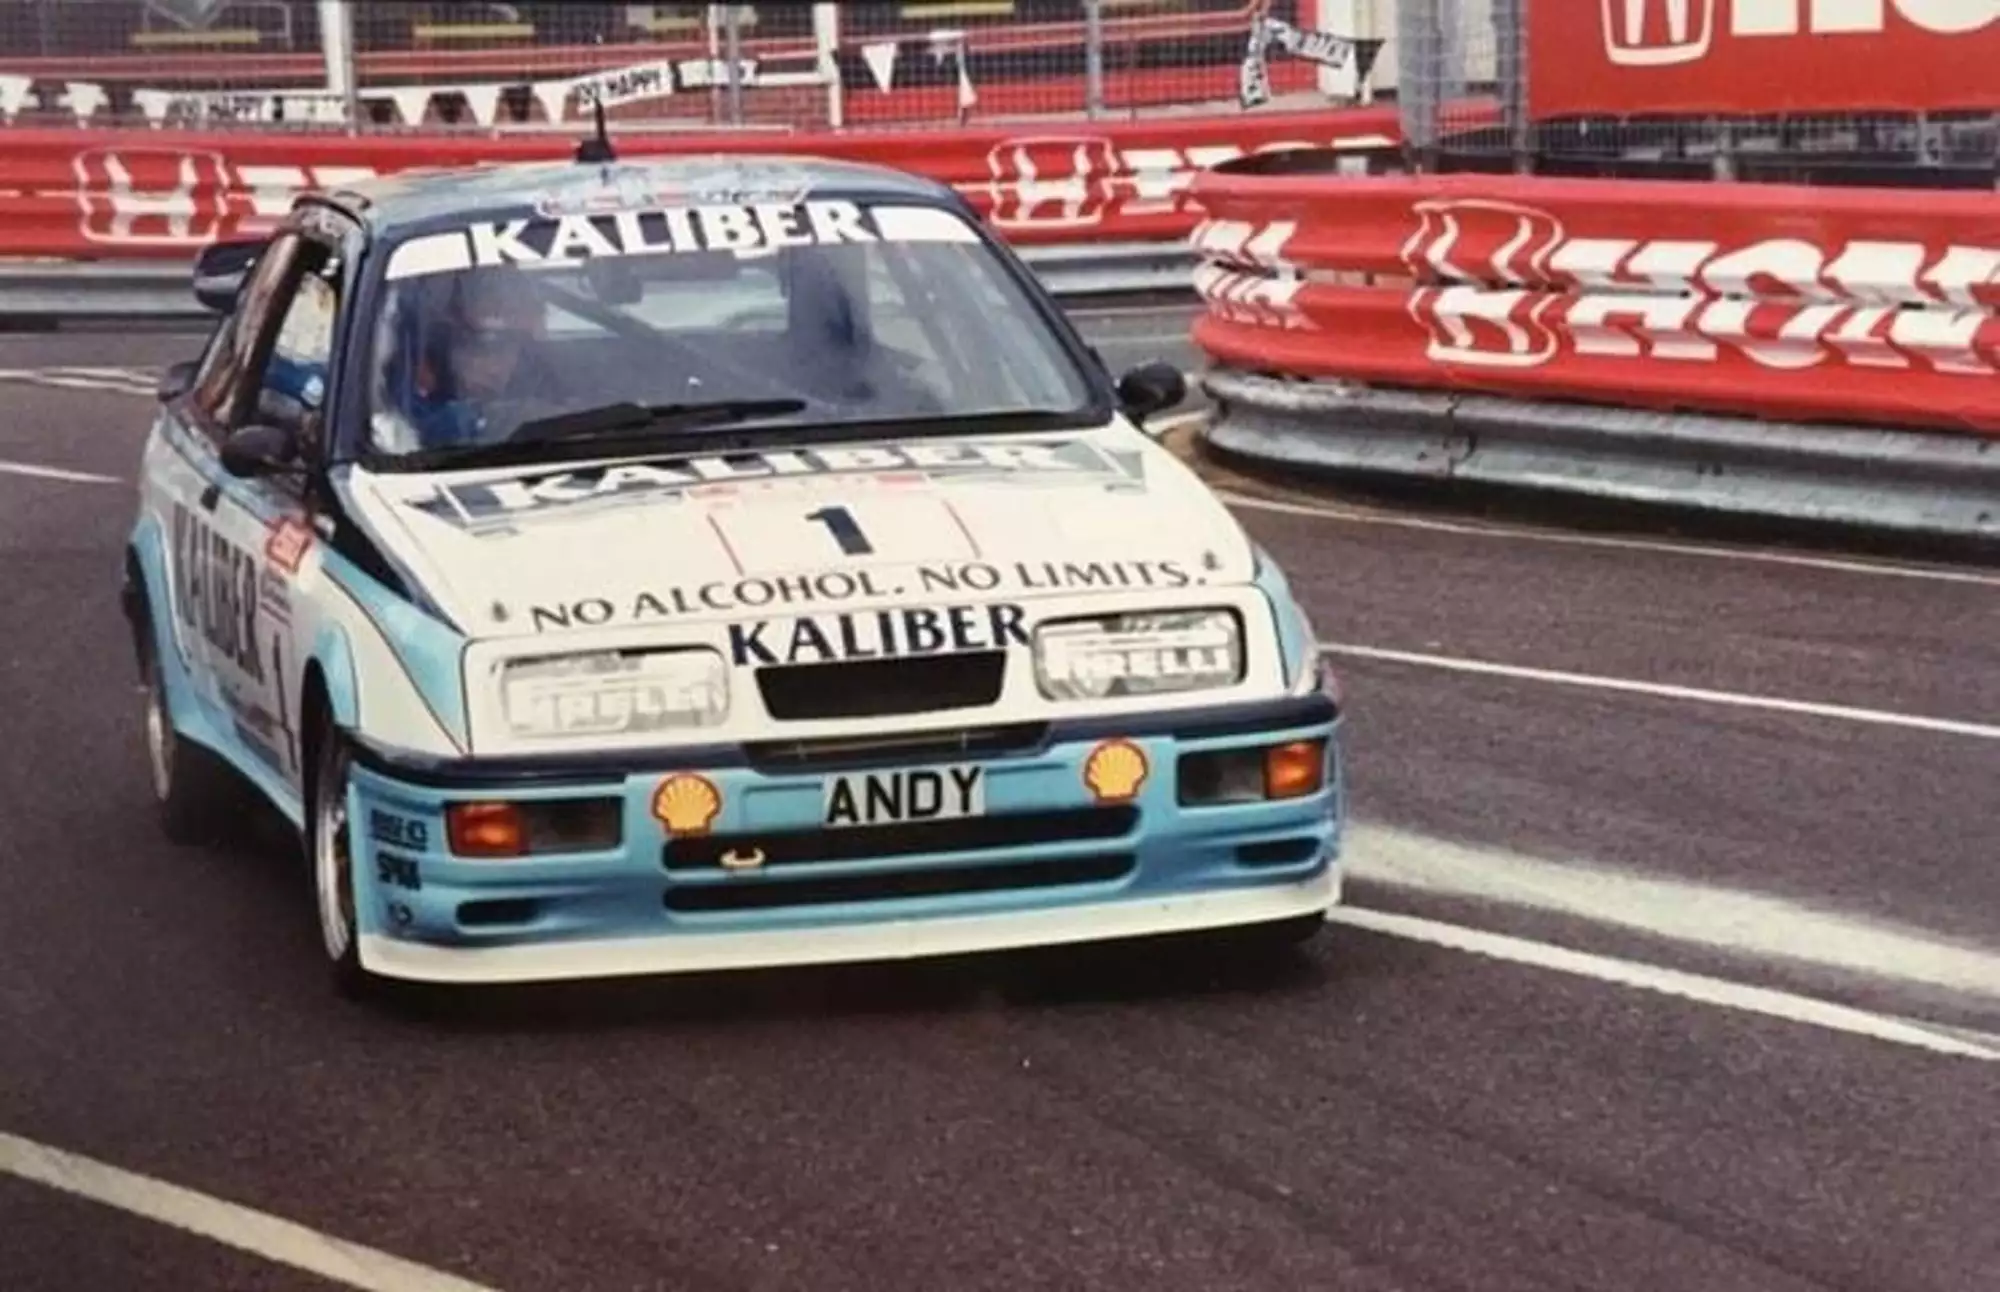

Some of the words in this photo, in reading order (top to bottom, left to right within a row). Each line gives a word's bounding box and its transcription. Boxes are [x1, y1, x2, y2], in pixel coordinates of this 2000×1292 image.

[468, 201, 878, 267] KALIBER
[488, 445, 1079, 509] KALIBER
[803, 505, 875, 556] 1
[530, 597, 616, 633] NO
[632, 568, 906, 619] ALCOHOL.
[918, 562, 1001, 594] NO
[1015, 560, 1207, 590] LIMITS.
[727, 602, 1032, 668] KALIBER
[826, 765, 981, 823] ANDY
